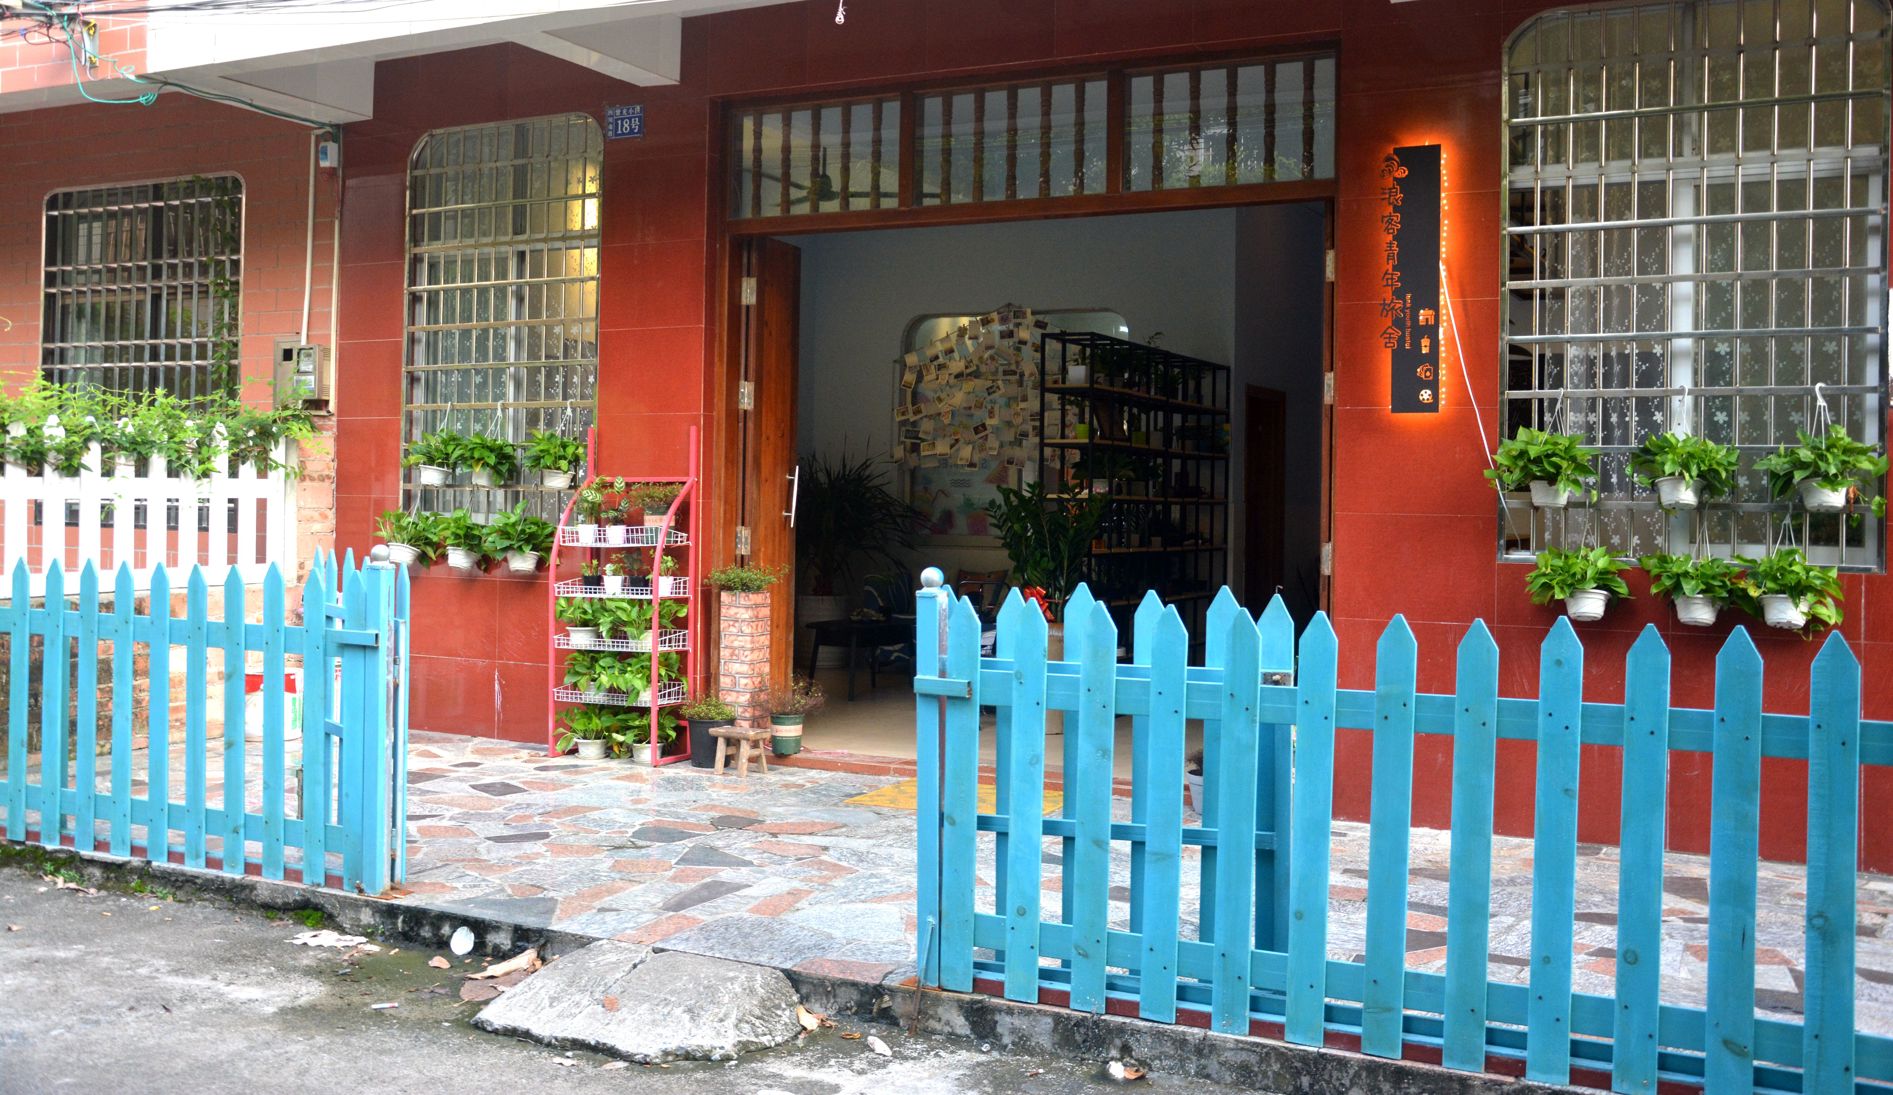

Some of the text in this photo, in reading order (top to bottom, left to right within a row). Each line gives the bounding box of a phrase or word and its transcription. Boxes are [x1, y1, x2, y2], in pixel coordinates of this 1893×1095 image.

[616, 117, 640, 134] 18号
[1379, 181, 1404, 350] 浪客青年旅舍
